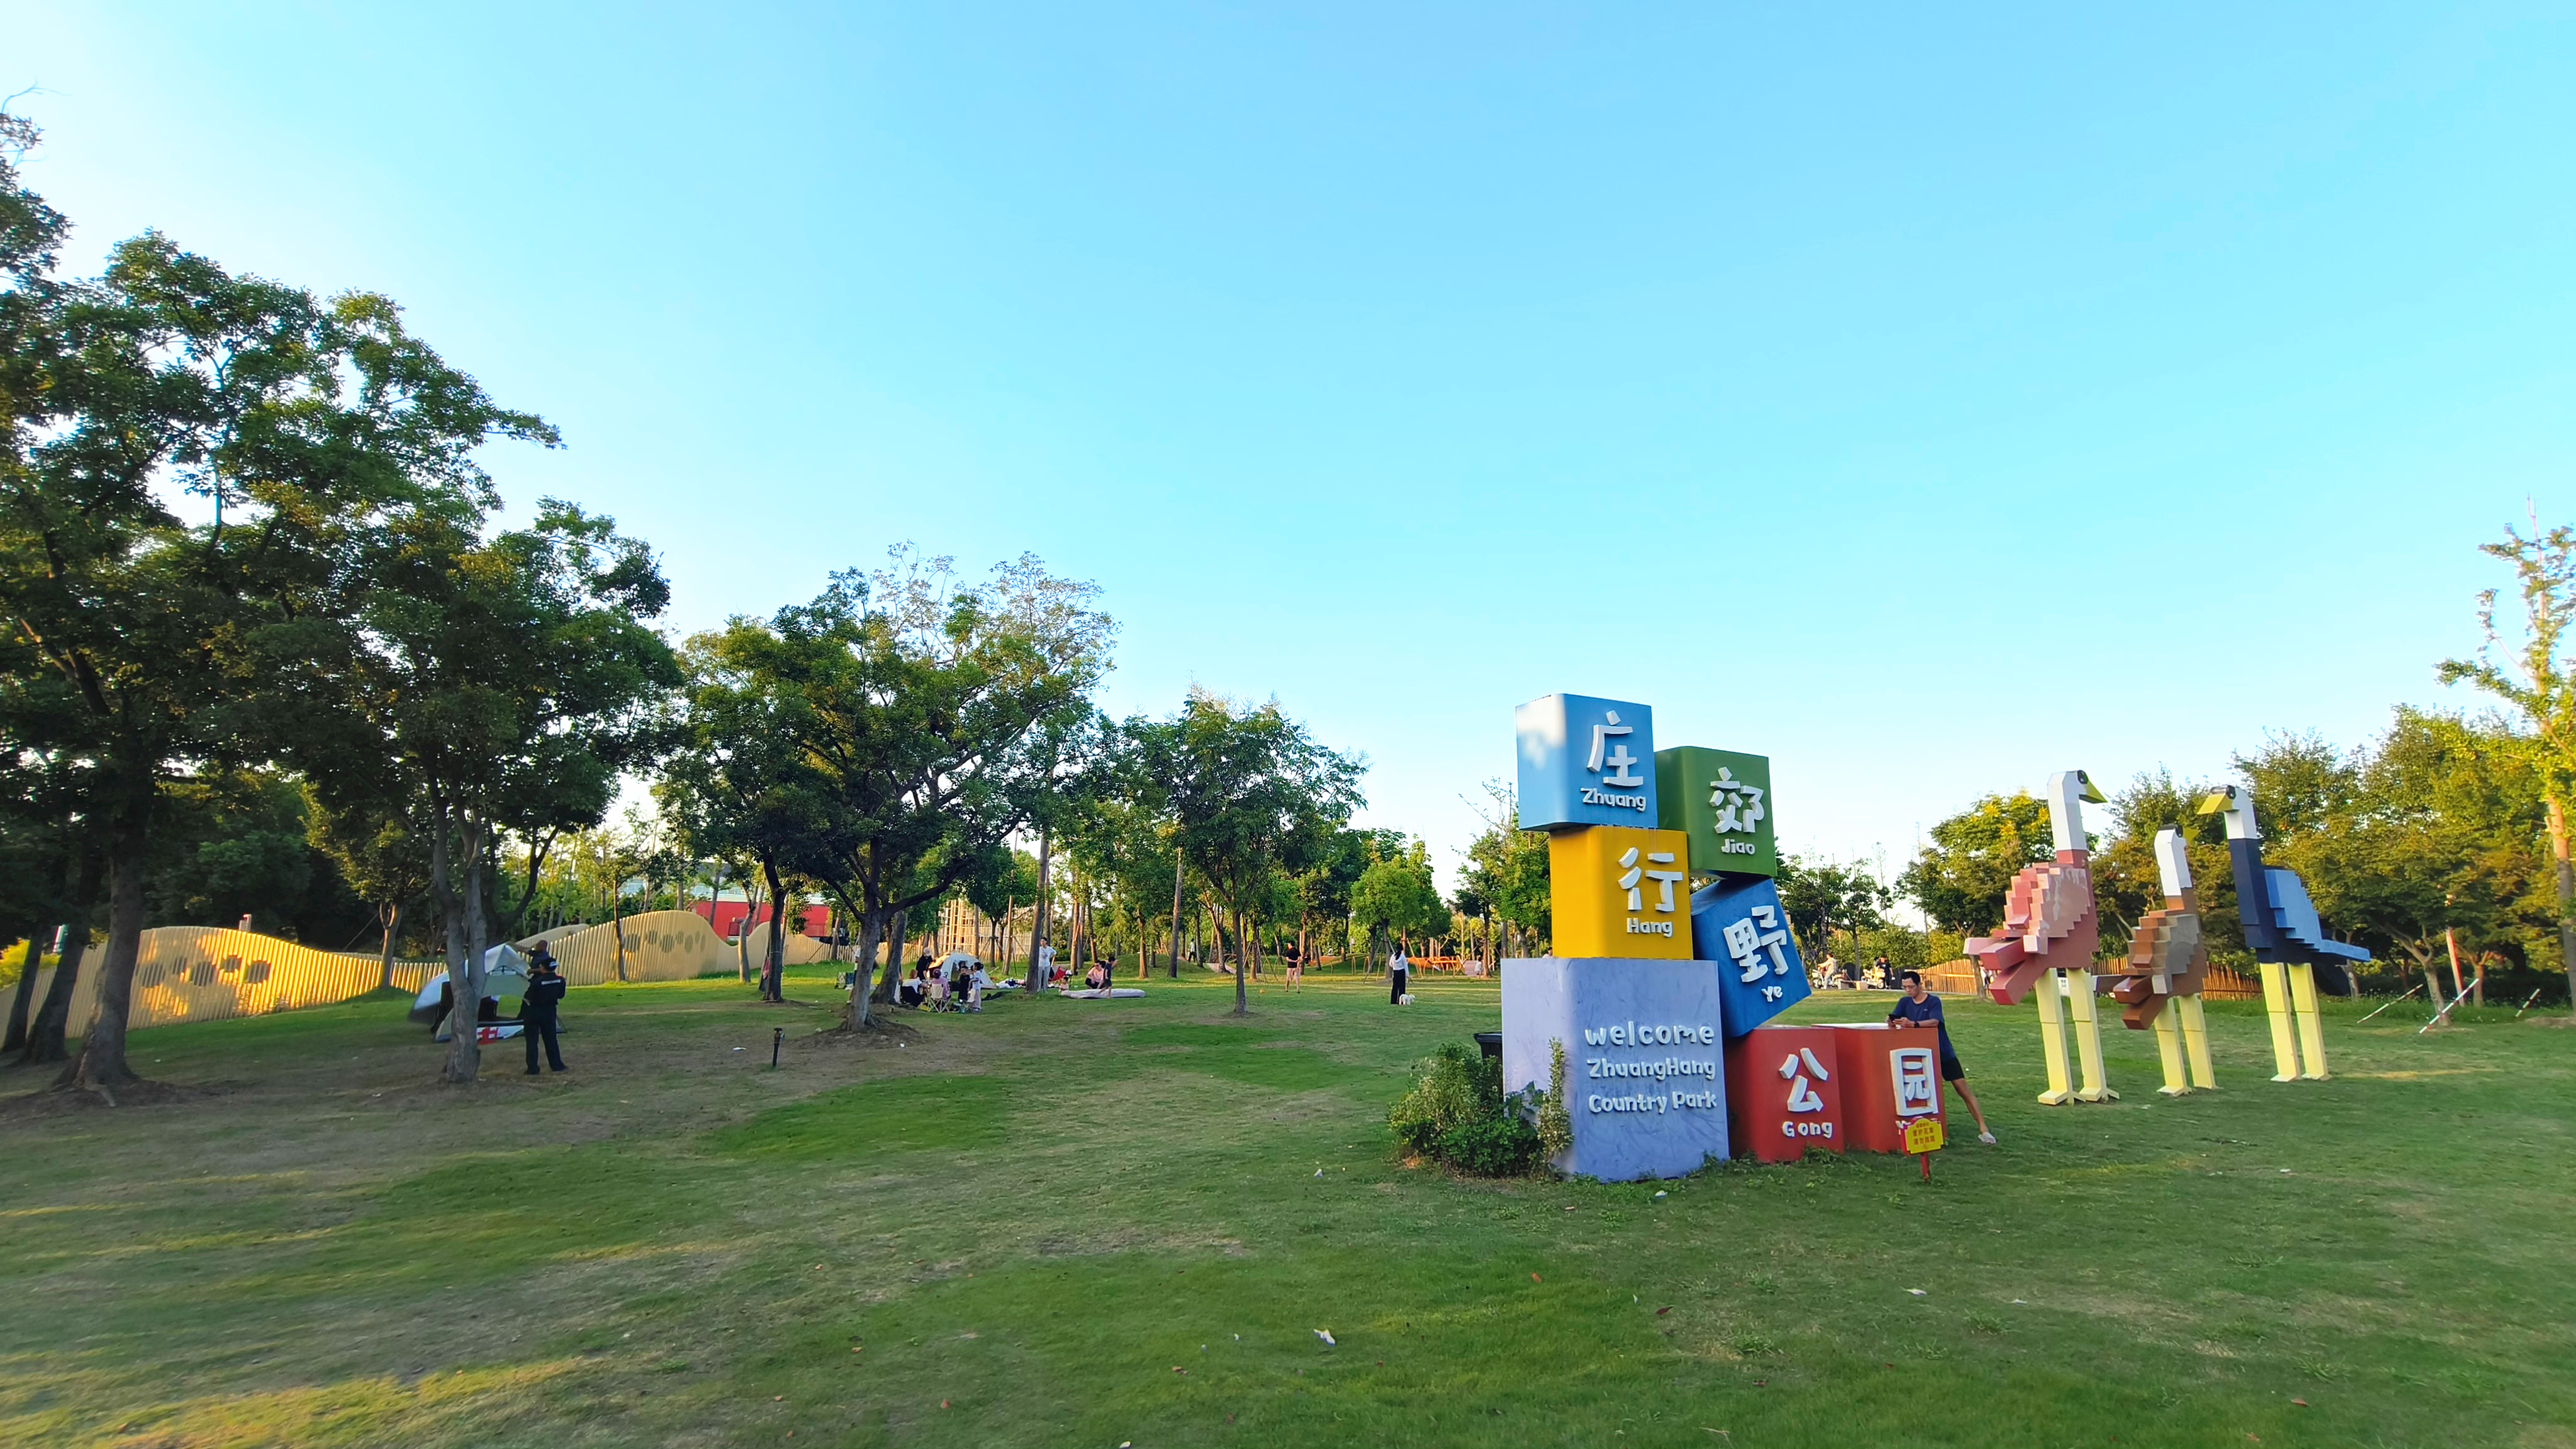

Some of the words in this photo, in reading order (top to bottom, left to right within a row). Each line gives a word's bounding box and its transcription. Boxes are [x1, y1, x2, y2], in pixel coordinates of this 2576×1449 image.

[1587, 710, 1643, 786] 庄
[1581, 788, 1647, 812] Zhuang
[1709, 766, 1765, 834] 郊
[1721, 838, 1756, 855] Jiao
[1618, 847, 1683, 912] 行
[1626, 917, 1674, 938] Hang
[1723, 905, 1789, 983] 野
[1585, 1021, 1715, 1046] welcome
[1587, 1058, 1715, 1080] ZhuangHang
[1779, 1047, 1828, 1112] 公
[1890, 1048, 1938, 1116] 园
[1589, 1094, 1668, 1114] Country
[1672, 1091, 1717, 1109] Park
[1782, 1121, 1833, 1138] Gong
